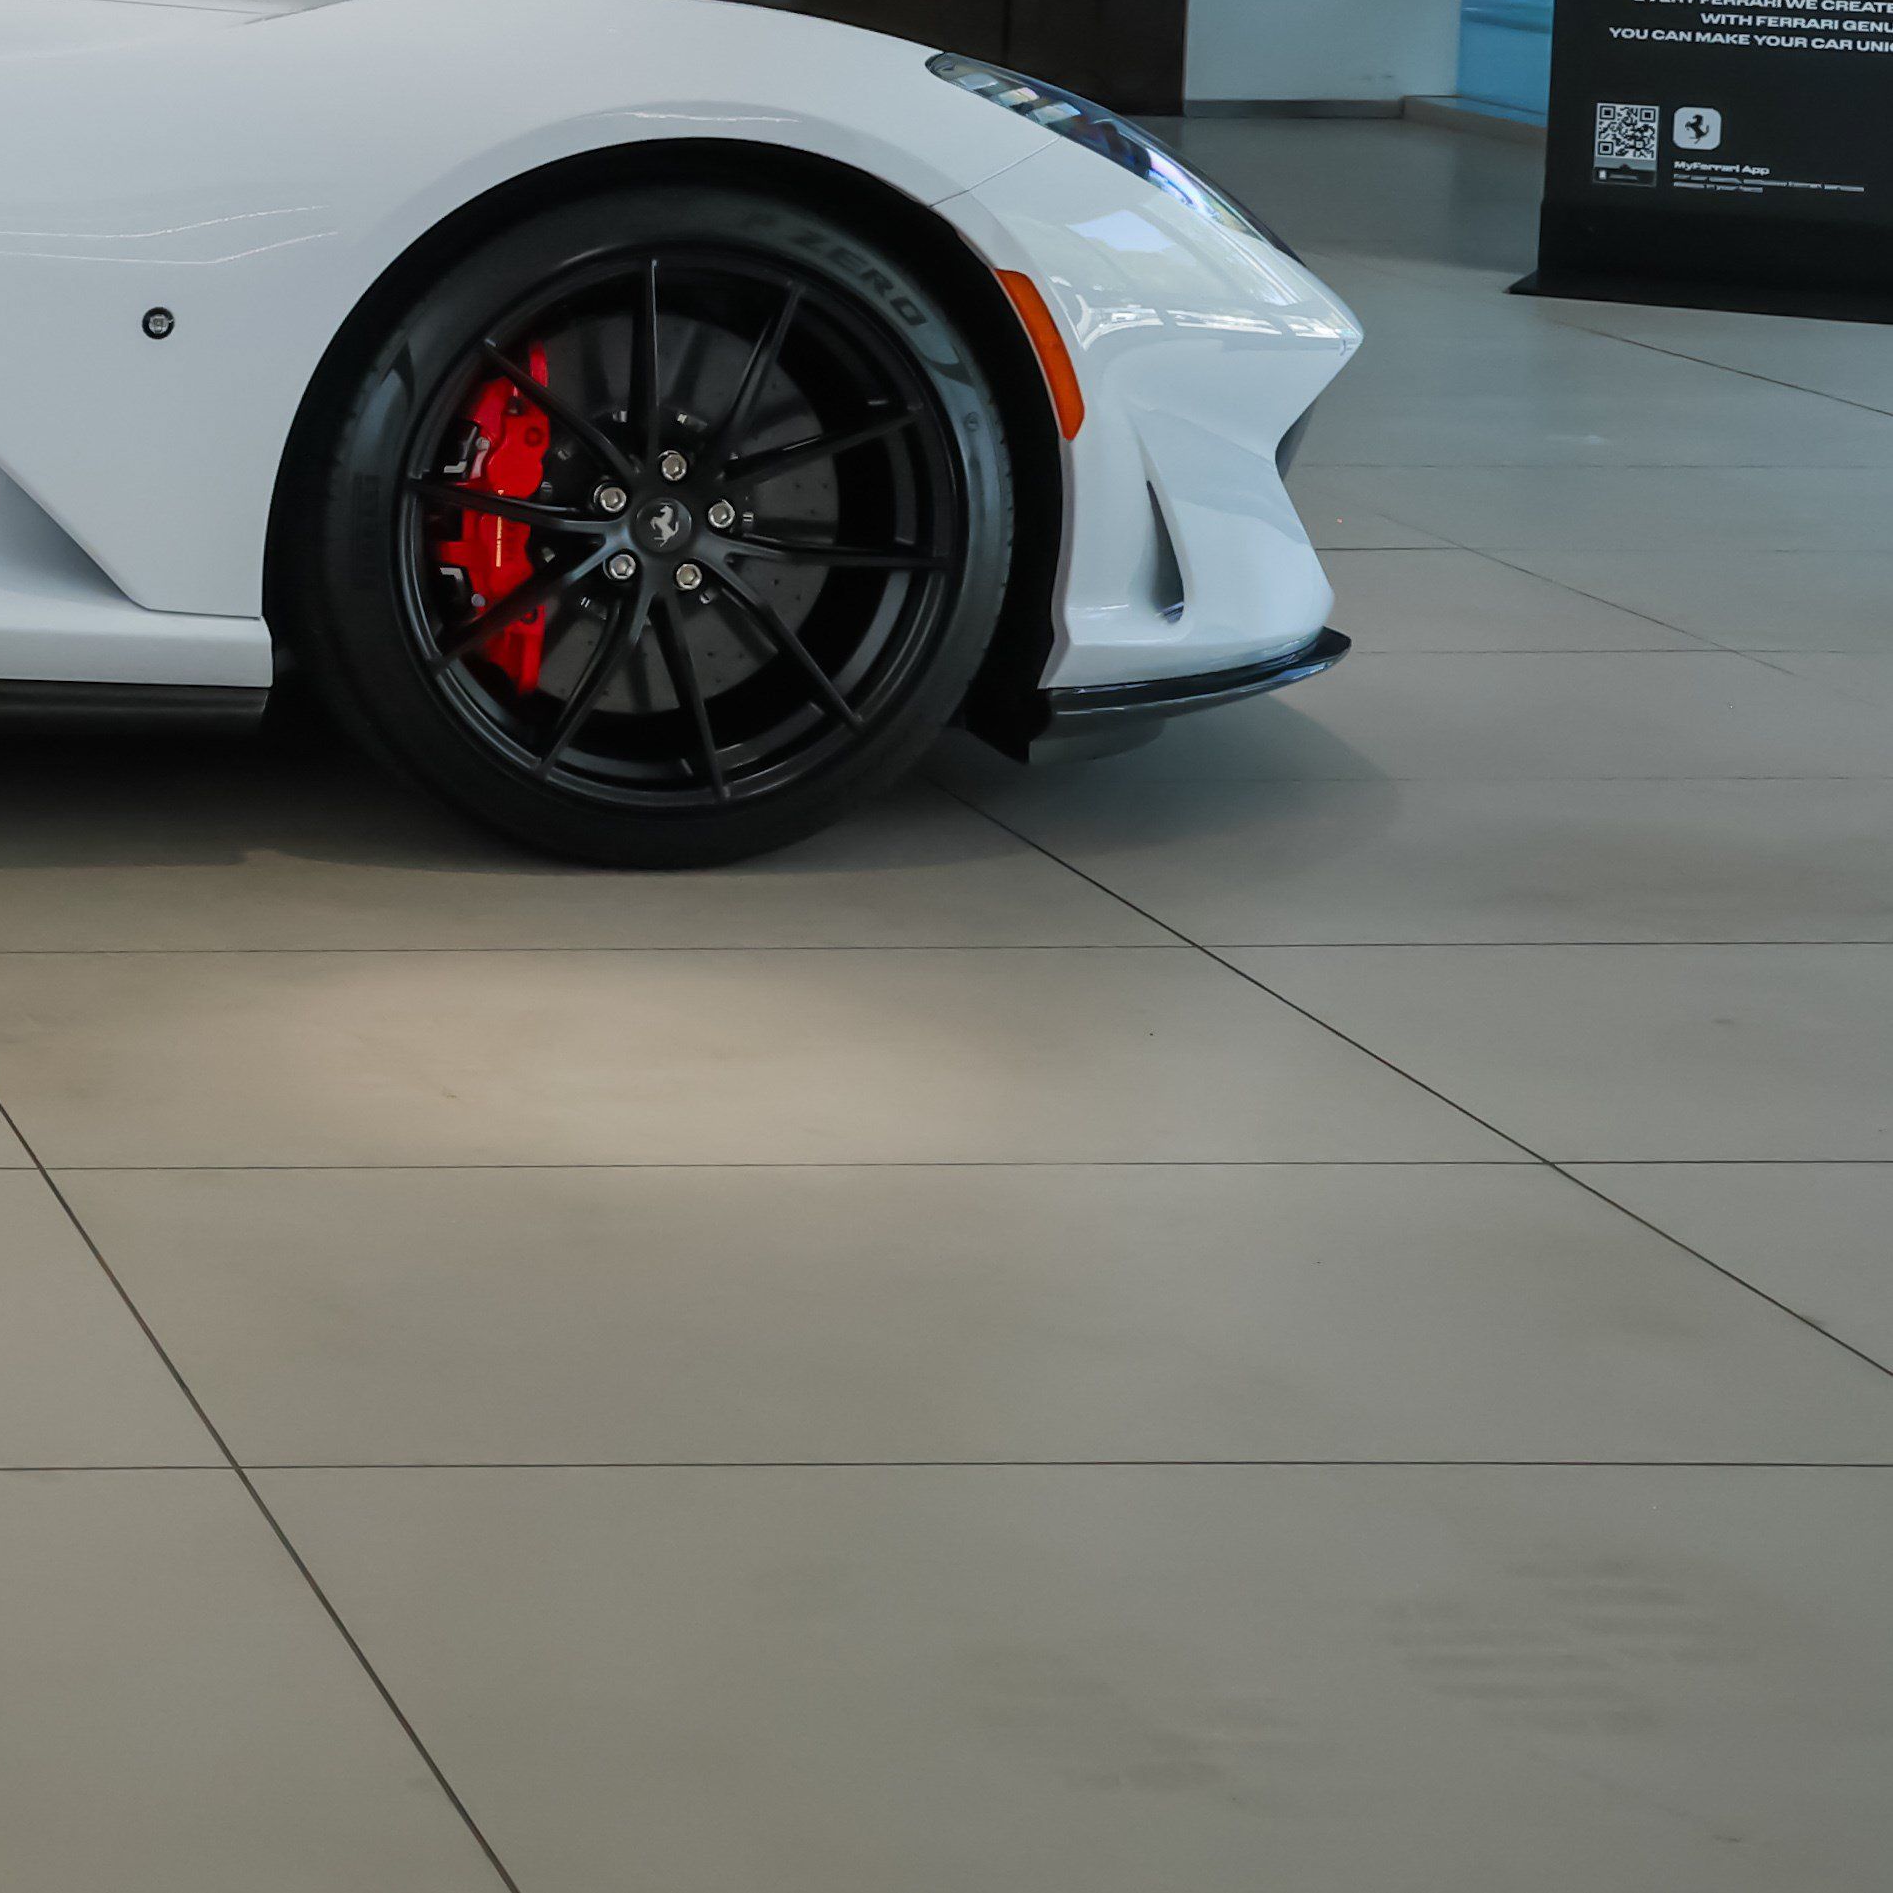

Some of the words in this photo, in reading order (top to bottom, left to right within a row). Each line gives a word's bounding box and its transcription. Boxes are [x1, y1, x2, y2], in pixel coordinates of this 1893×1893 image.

[1700, 12, 1753, 27] WITH
[1756, 15, 1839, 30] FERRARI
[1609, 26, 1649, 40] YOU
[1651, 29, 1692, 42] CAN
[1695, 31, 1751, 46] MAKE
[1753, 34, 1808, 48] YOUR
[1810, 37, 1853, 51] CAR
[1856, 39, 1893, 53] UNI
[1674, 160, 1740, 173] MyFerrari
[1742, 164, 1770, 175] App
